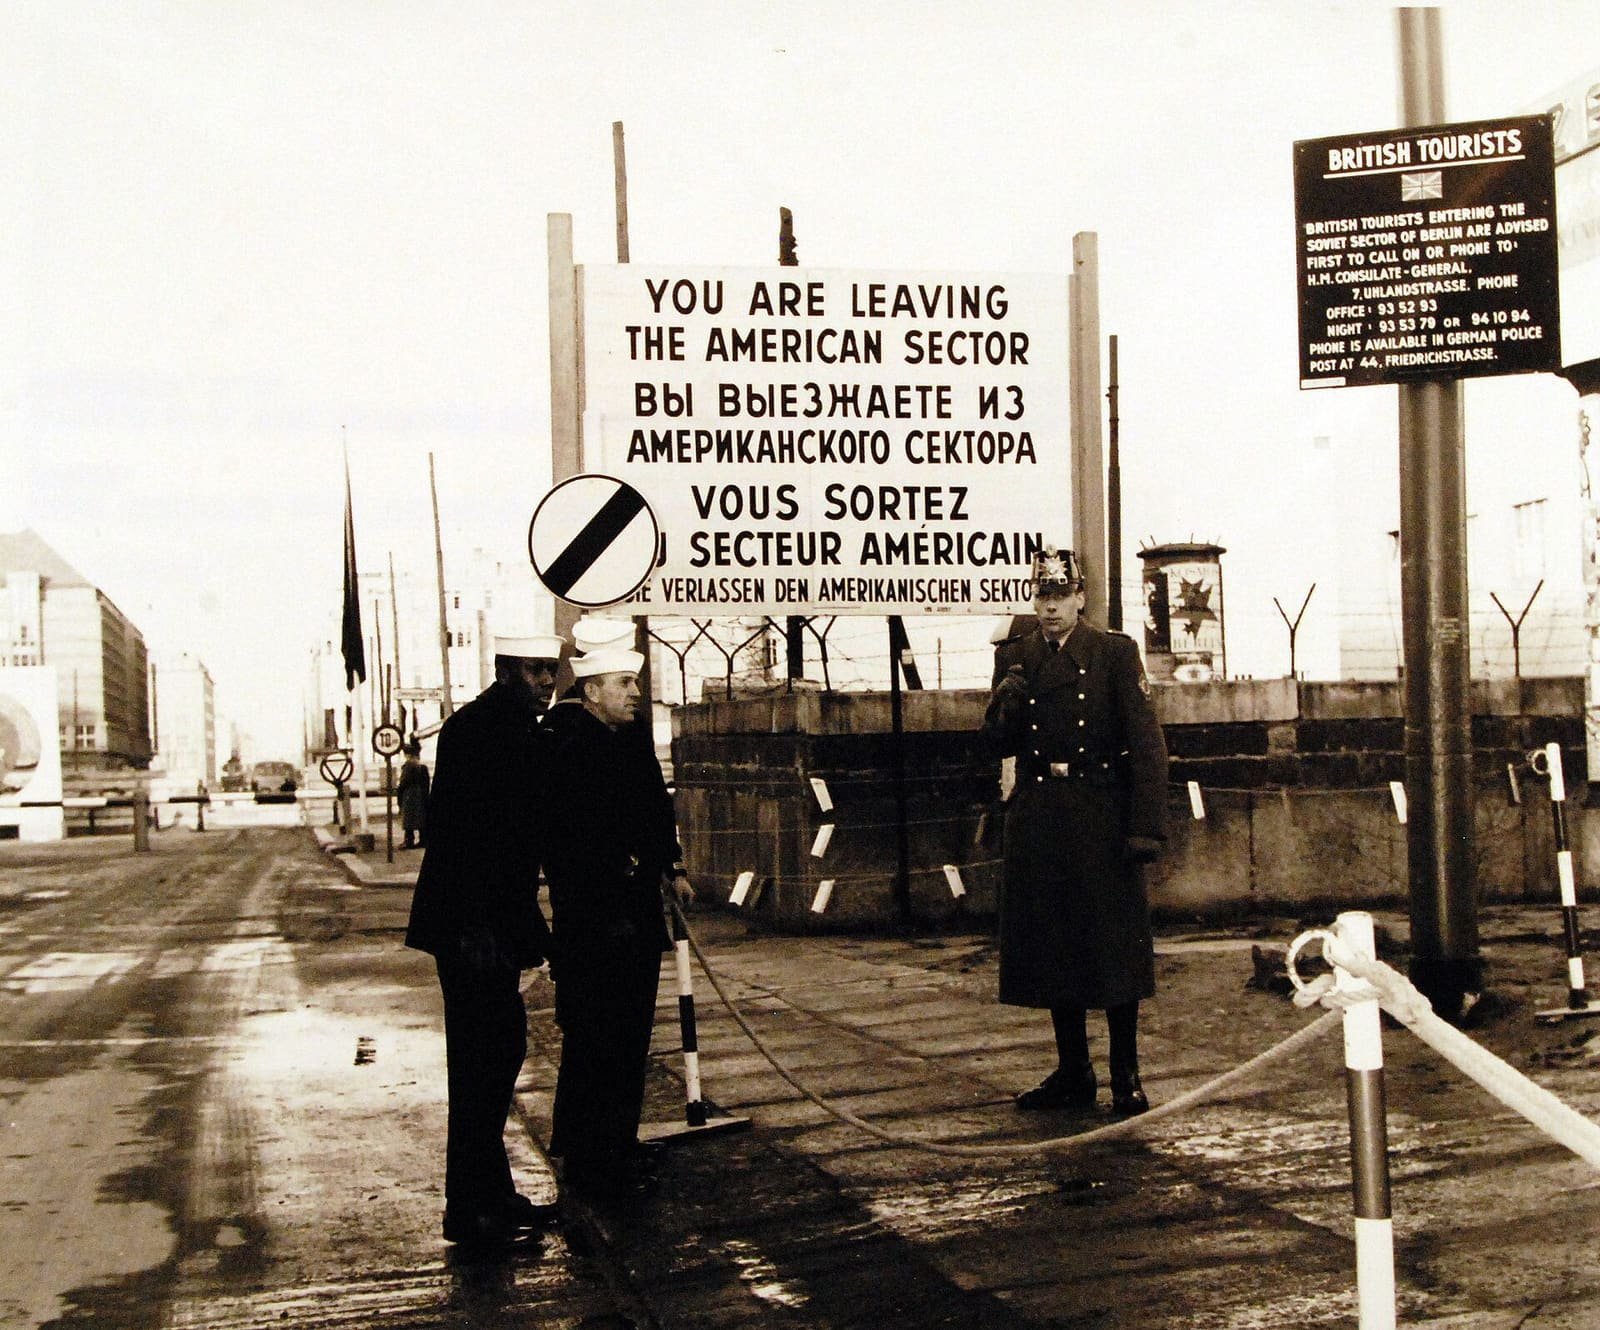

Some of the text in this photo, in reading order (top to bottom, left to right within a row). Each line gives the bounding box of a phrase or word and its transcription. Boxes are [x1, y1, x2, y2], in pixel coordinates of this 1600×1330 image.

[1329, 129, 1521, 170] BRITISH TOURISTS
[1306, 203, 1524, 234] BRITISH TOURISTS ENTERING THE
[1307, 219, 1548, 251] SOVIET SECTOR OF BERLIN ARE ADVISED
[1307, 255, 1342, 269] FIRST
[1347, 253, 1364, 265] TO
[1369, 250, 1398, 263] CALL
[1403, 248, 1419, 260] ON
[1426, 246, 1443, 258] OR
[1450, 242, 1489, 256] PHONE
[1478, 275, 1517, 289] PHONE
[645, 278, 1008, 320] YOU ARE LEAVING
[1378, 303, 1394, 315] 93
[1399, 301, 1415, 313] 52
[1420, 299, 1437, 312] 93
[1380, 320, 1395, 332] 93
[1399, 319, 1415, 331] 53
[1420, 317, 1435, 329] 79
[1472, 313, 1489, 325] 94
[1493, 311, 1507, 323] 10
[1511, 310, 1529, 322] 94
[626, 326, 1028, 365] THE AMERICAN SECTOR
[1310, 326, 1542, 354] PHONE IS AVAILABLE IN GERMAN POLICE
[1311, 360, 1336, 372] POST
[1340, 358, 1354, 369] AT
[635, 383, 1025, 421] ВЫ ВЫЕЗЖАЕТЕ ИЗ
[627, 430, 1036, 464] АМЕРИКАНСКОГО СЕКТОРА
[691, 484, 968, 521] VOUS SORTEZ
[688, 529, 842, 568] SECTEUR
[860, 523, 1042, 567] AMÉRICAIN
[662, 578, 764, 602] VERLASSEN
[776, 579, 808, 602] DEN
[819, 578, 970, 603] AMERIKANISCHEN
[979, 577, 1032, 603] SEKTO
